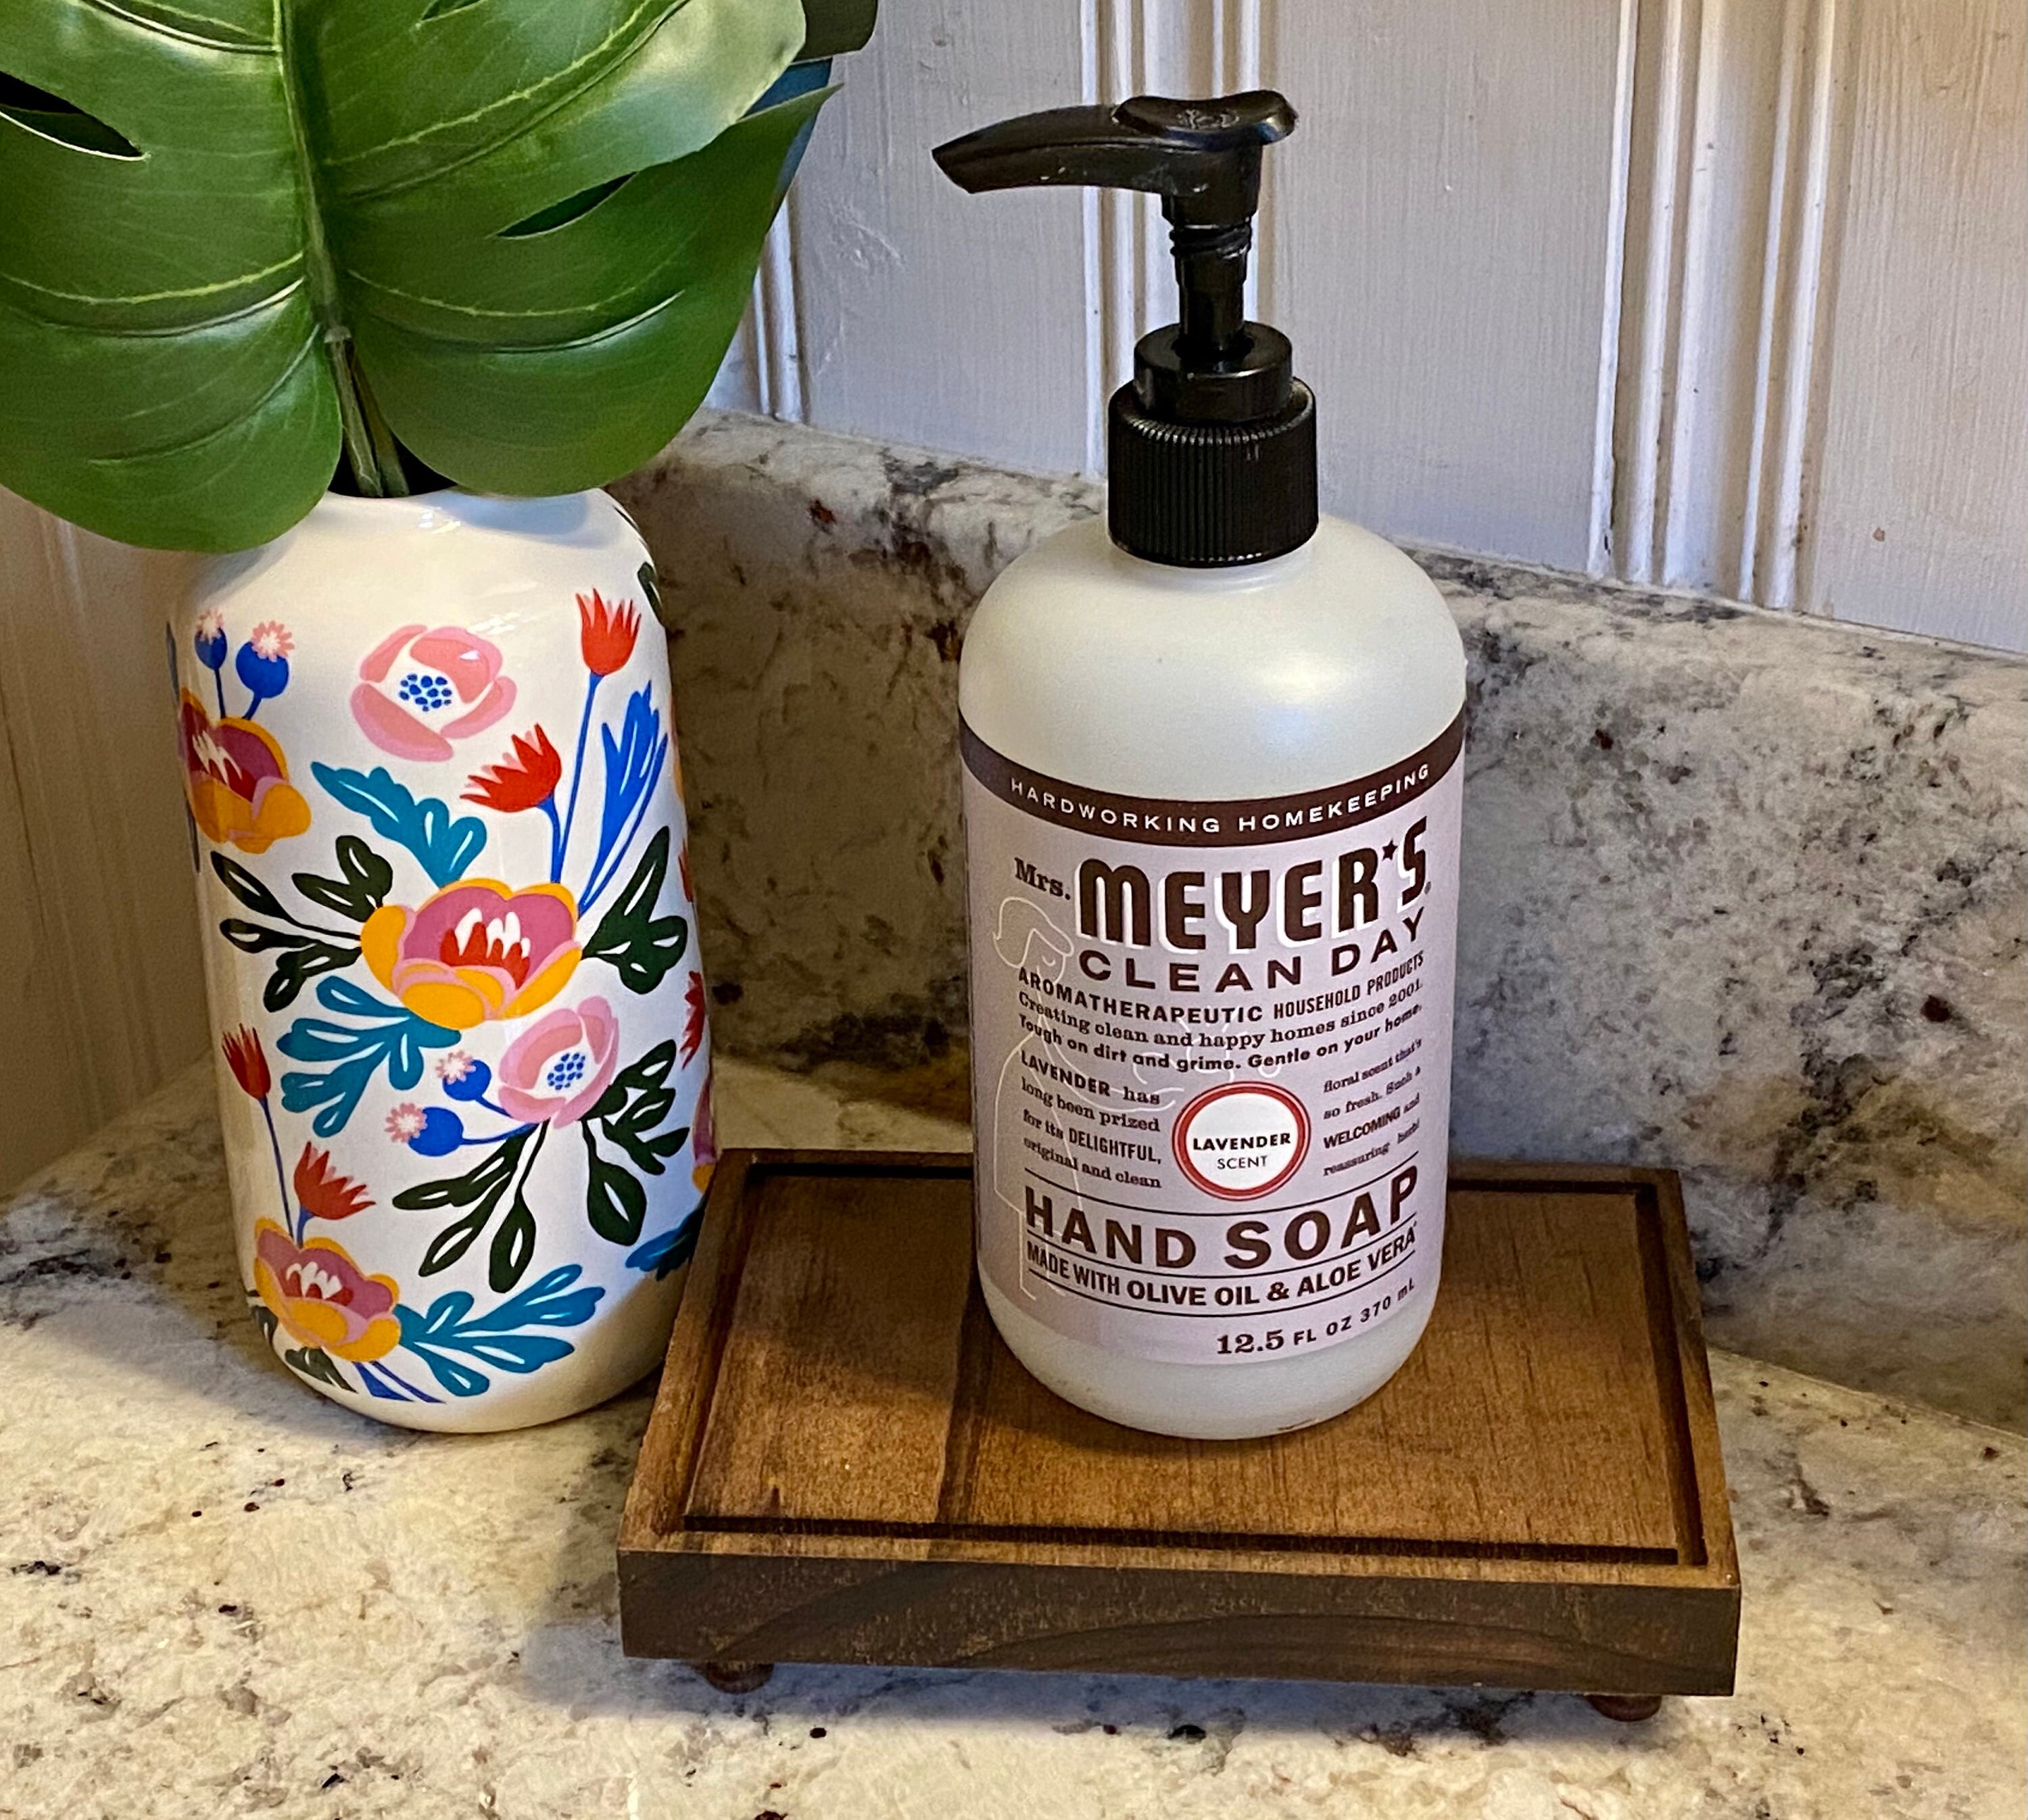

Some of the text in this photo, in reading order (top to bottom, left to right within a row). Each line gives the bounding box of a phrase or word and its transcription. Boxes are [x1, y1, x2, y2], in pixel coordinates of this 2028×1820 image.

[1011, 764, 1428, 833] HARDWORKING HOMEKEEPING
[1015, 857, 1072, 901] Mrs.
[1080, 907, 1424, 992] CLEAN DAY
[1018, 950, 1424, 1024] AROMATHERAPEUTIC HOUSEHOLD PRODUCTS
[1019, 978, 1423, 1050] Creating clean and happy homes since 2001.
[1019, 1003, 1422, 1072] Tough on dirt and grime. Gentle on your home.
[1021, 1050, 1160, 1105] LAVENDER has
[1323, 1072, 1359, 1093] floral
[1361, 1057, 1393, 1080] scent
[1021, 1076, 1161, 1132] long been prized
[1323, 1107, 1341, 1120] so
[1345, 1091, 1382, 1113] fresh.
[1323, 1093, 1420, 1149] WELCOMING and
[1023, 1109, 1161, 1165] for its DELIGHTFUL,
[1023, 1137, 1161, 1188] original and clean
[1193, 1133, 1291, 1151] LAVENDER
[1217, 1155, 1268, 1170] SCENT
[1323, 1142, 1390, 1176] reassuring
[1025, 1165, 1418, 1269] HAND SOAP
[1027, 1240, 1069, 1280] MADE
[1074, 1266, 1120, 1296] WITH
[1127, 1280, 1206, 1306] OLIVE
[1215, 1286, 1259, 1306] OIL
[1267, 1282, 1289, 1301] &
[1297, 1260, 1361, 1297] ALOE
[1217, 1277, 1414, 1354] 12.5 FL OZ 370 mL
